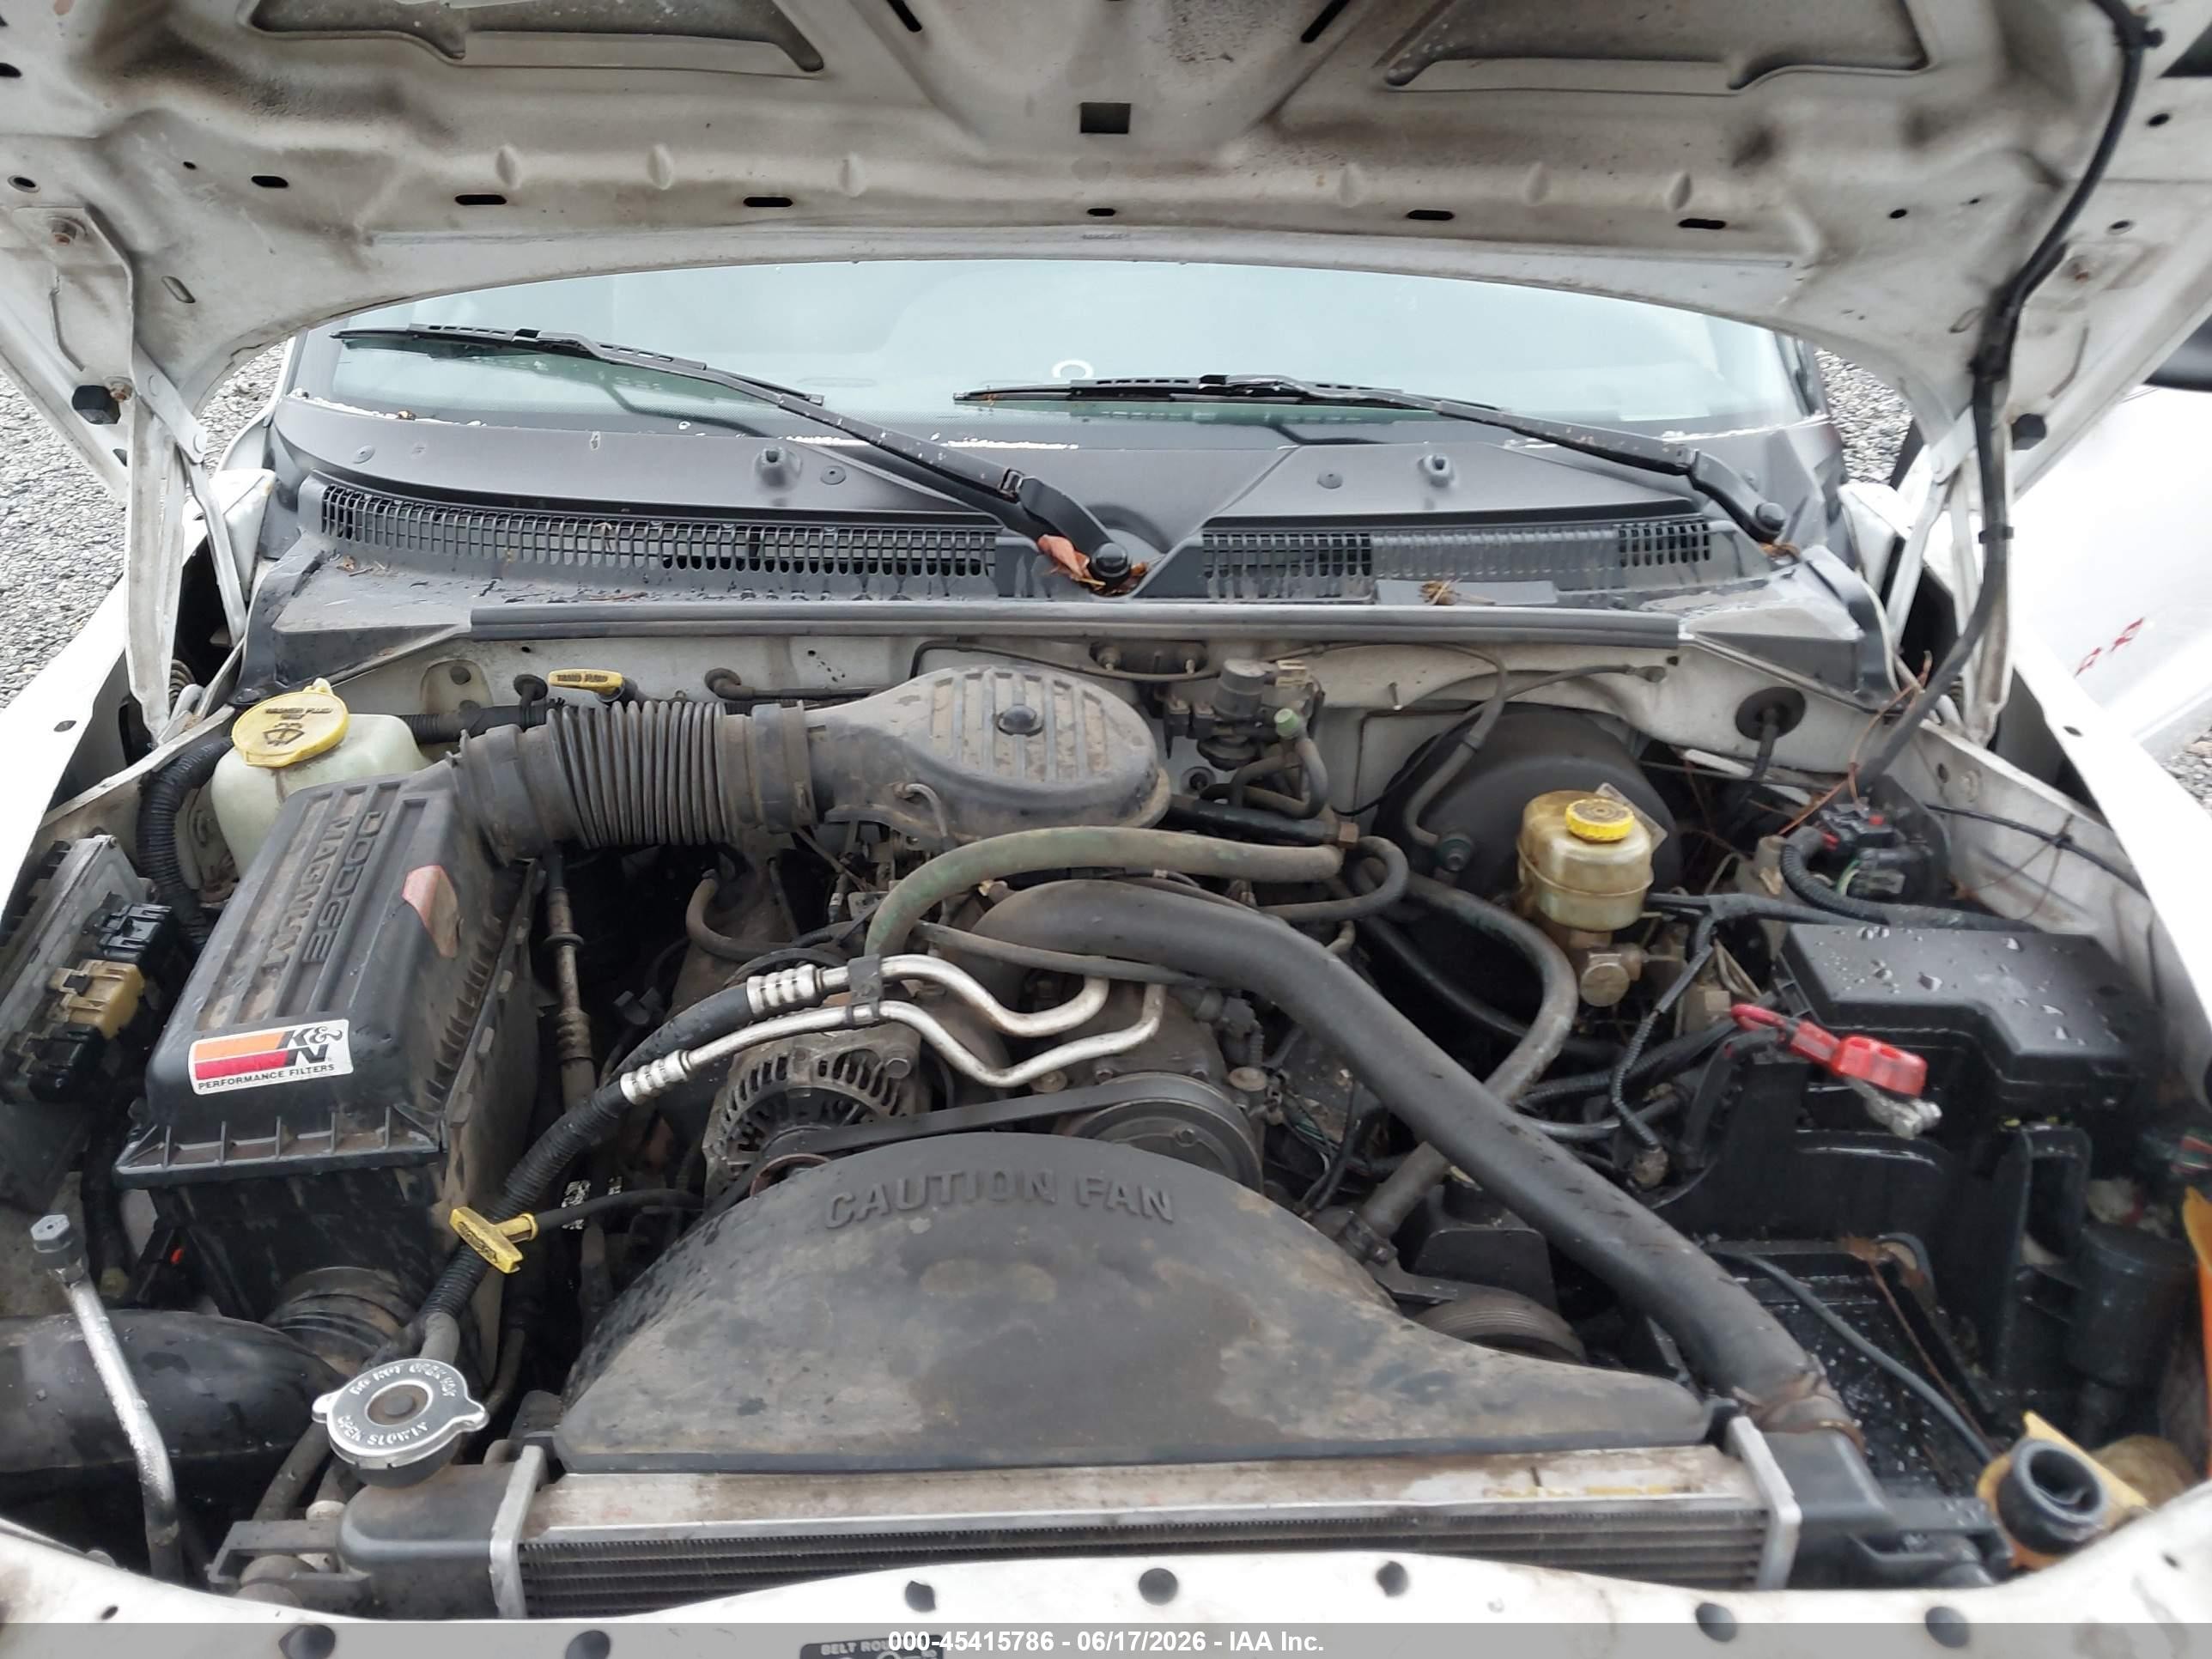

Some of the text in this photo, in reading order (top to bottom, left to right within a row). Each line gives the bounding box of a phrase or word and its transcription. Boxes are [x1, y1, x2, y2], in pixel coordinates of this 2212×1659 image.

[260, 815, 353, 971] MAGNUM
[302, 810, 388, 963] DODGE
[198, 1063, 335, 1091] PERFORMANCE FILTERS
[825, 1169, 1174, 1230] CAUTION FAN
[367, 1421, 429, 1446] SLOWLY
[820, 1642, 857, 1656] BELT
